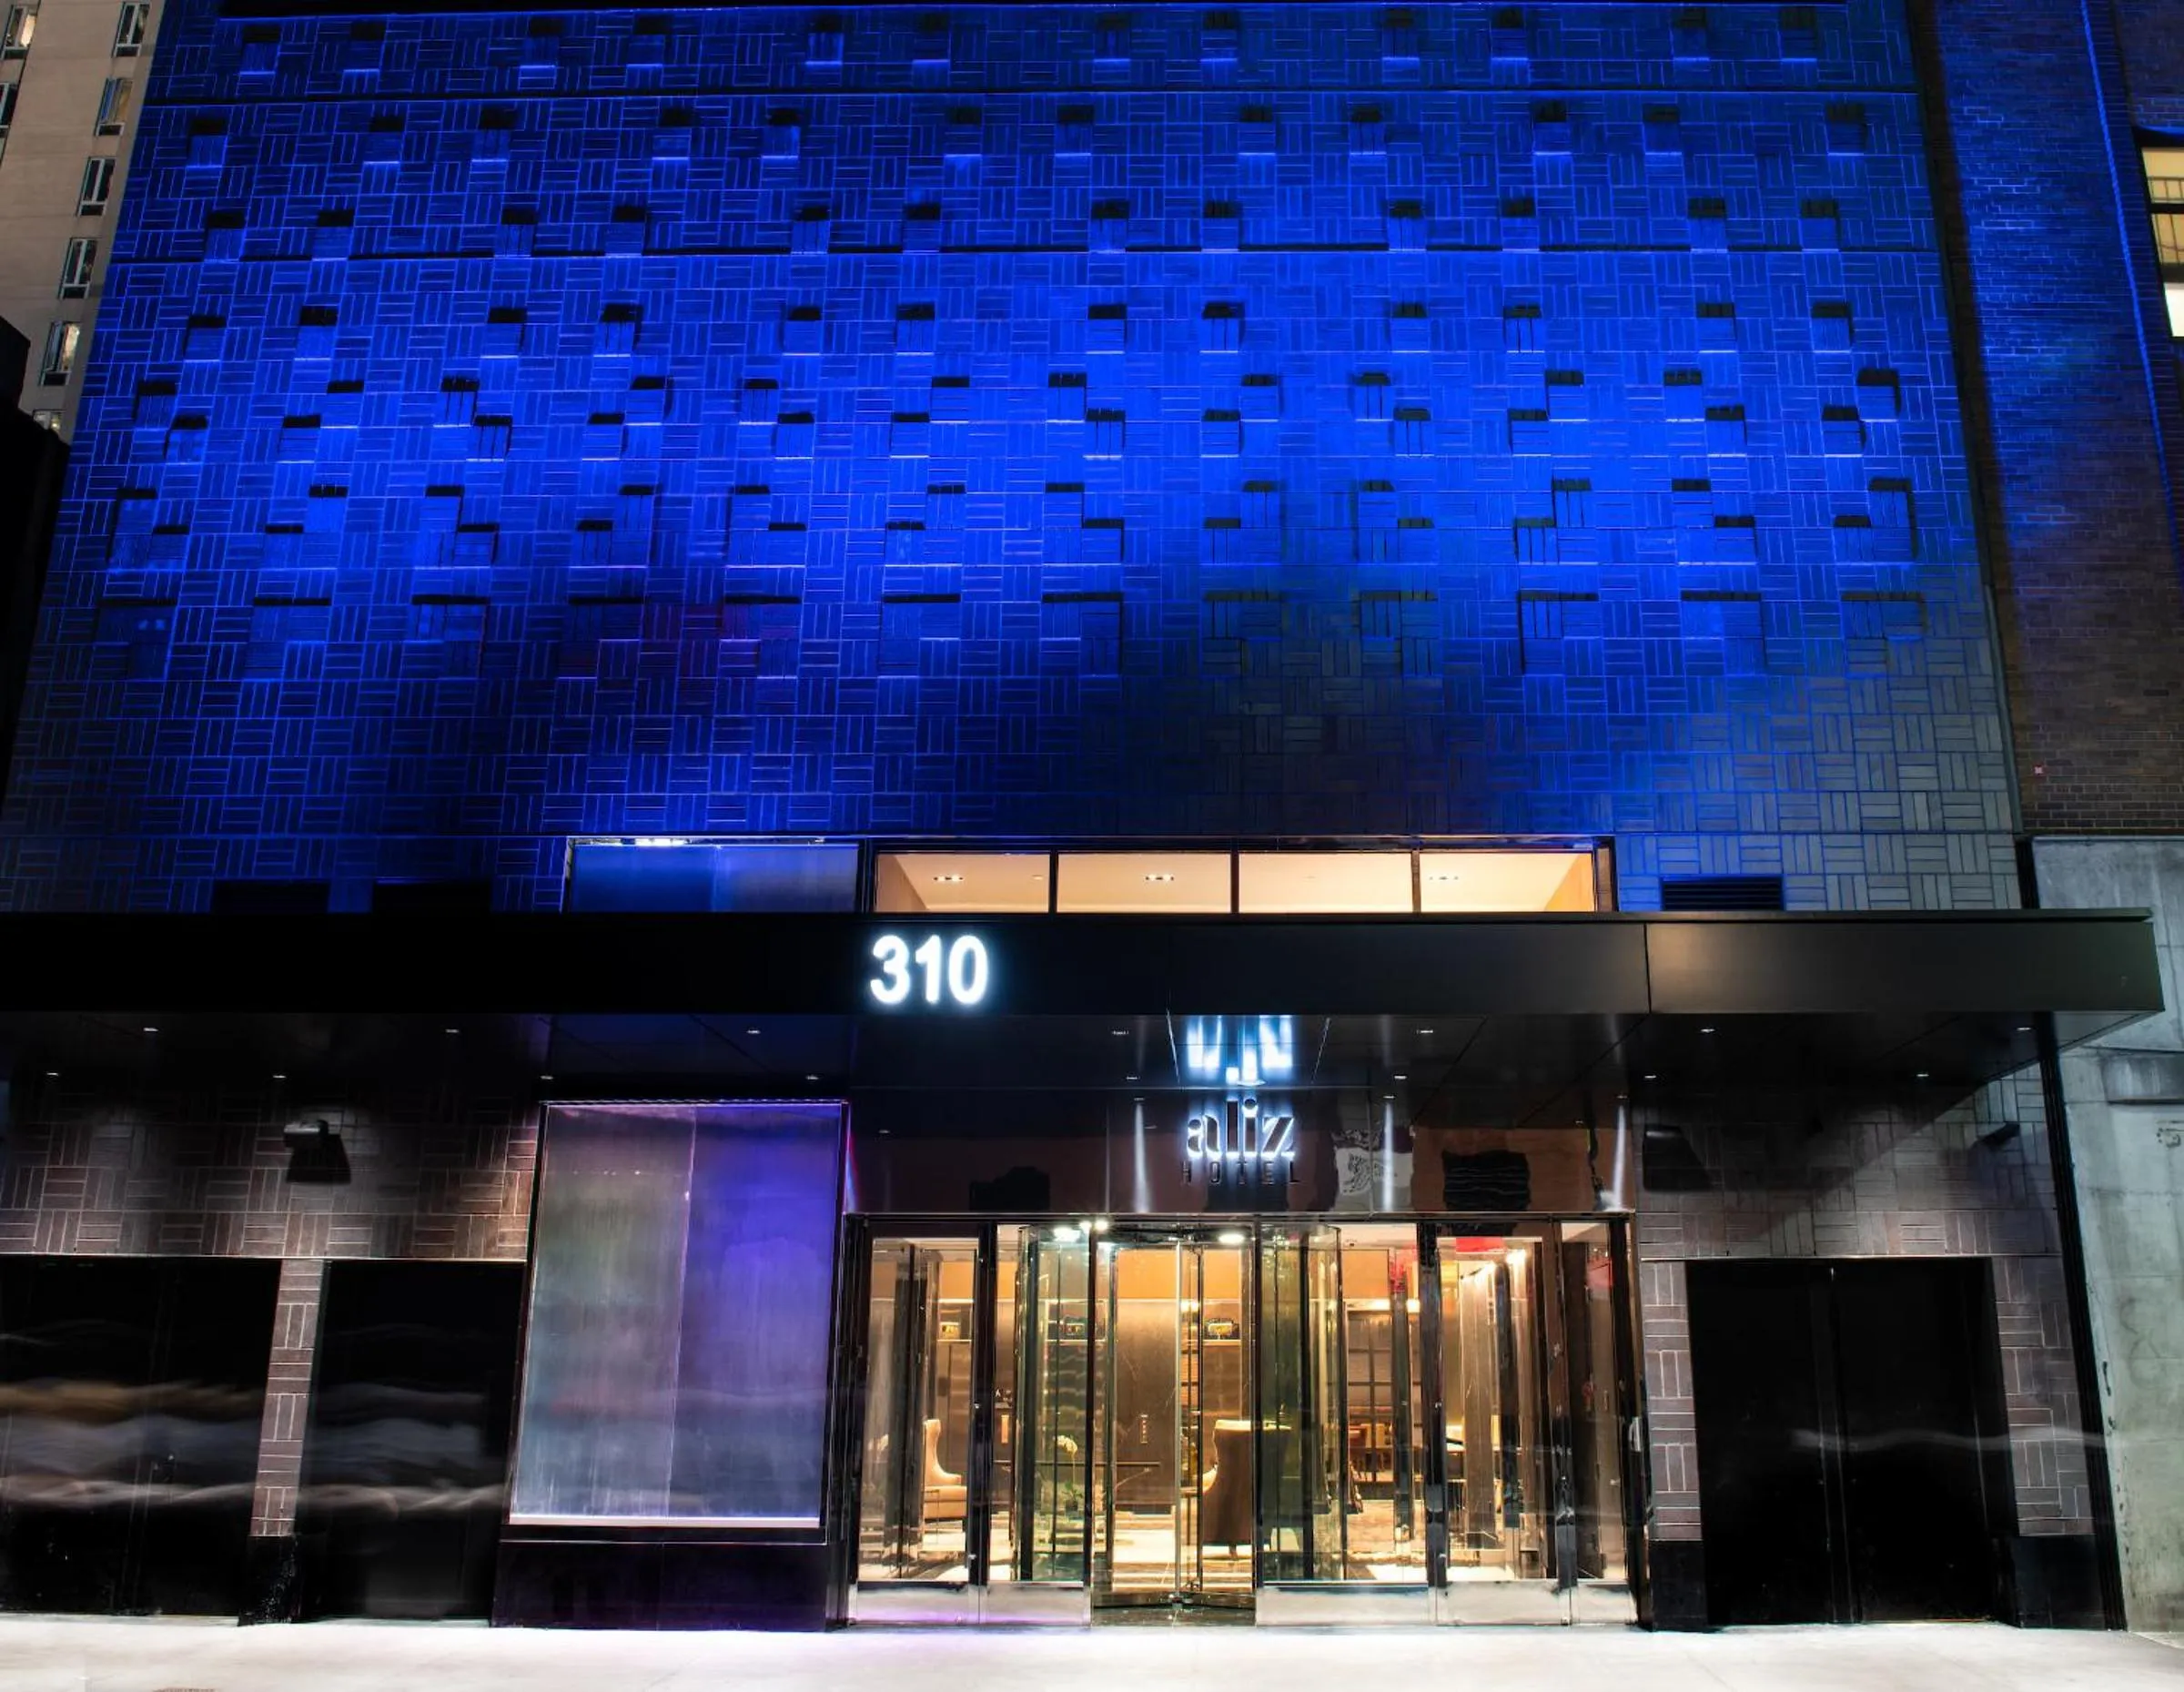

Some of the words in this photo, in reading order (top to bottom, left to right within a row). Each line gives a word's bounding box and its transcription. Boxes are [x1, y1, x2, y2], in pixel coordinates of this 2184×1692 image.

[870, 934, 989, 1004] 310
[1186, 1098, 1296, 1159] aliz
[1182, 1160, 1301, 1185] HOTEL
